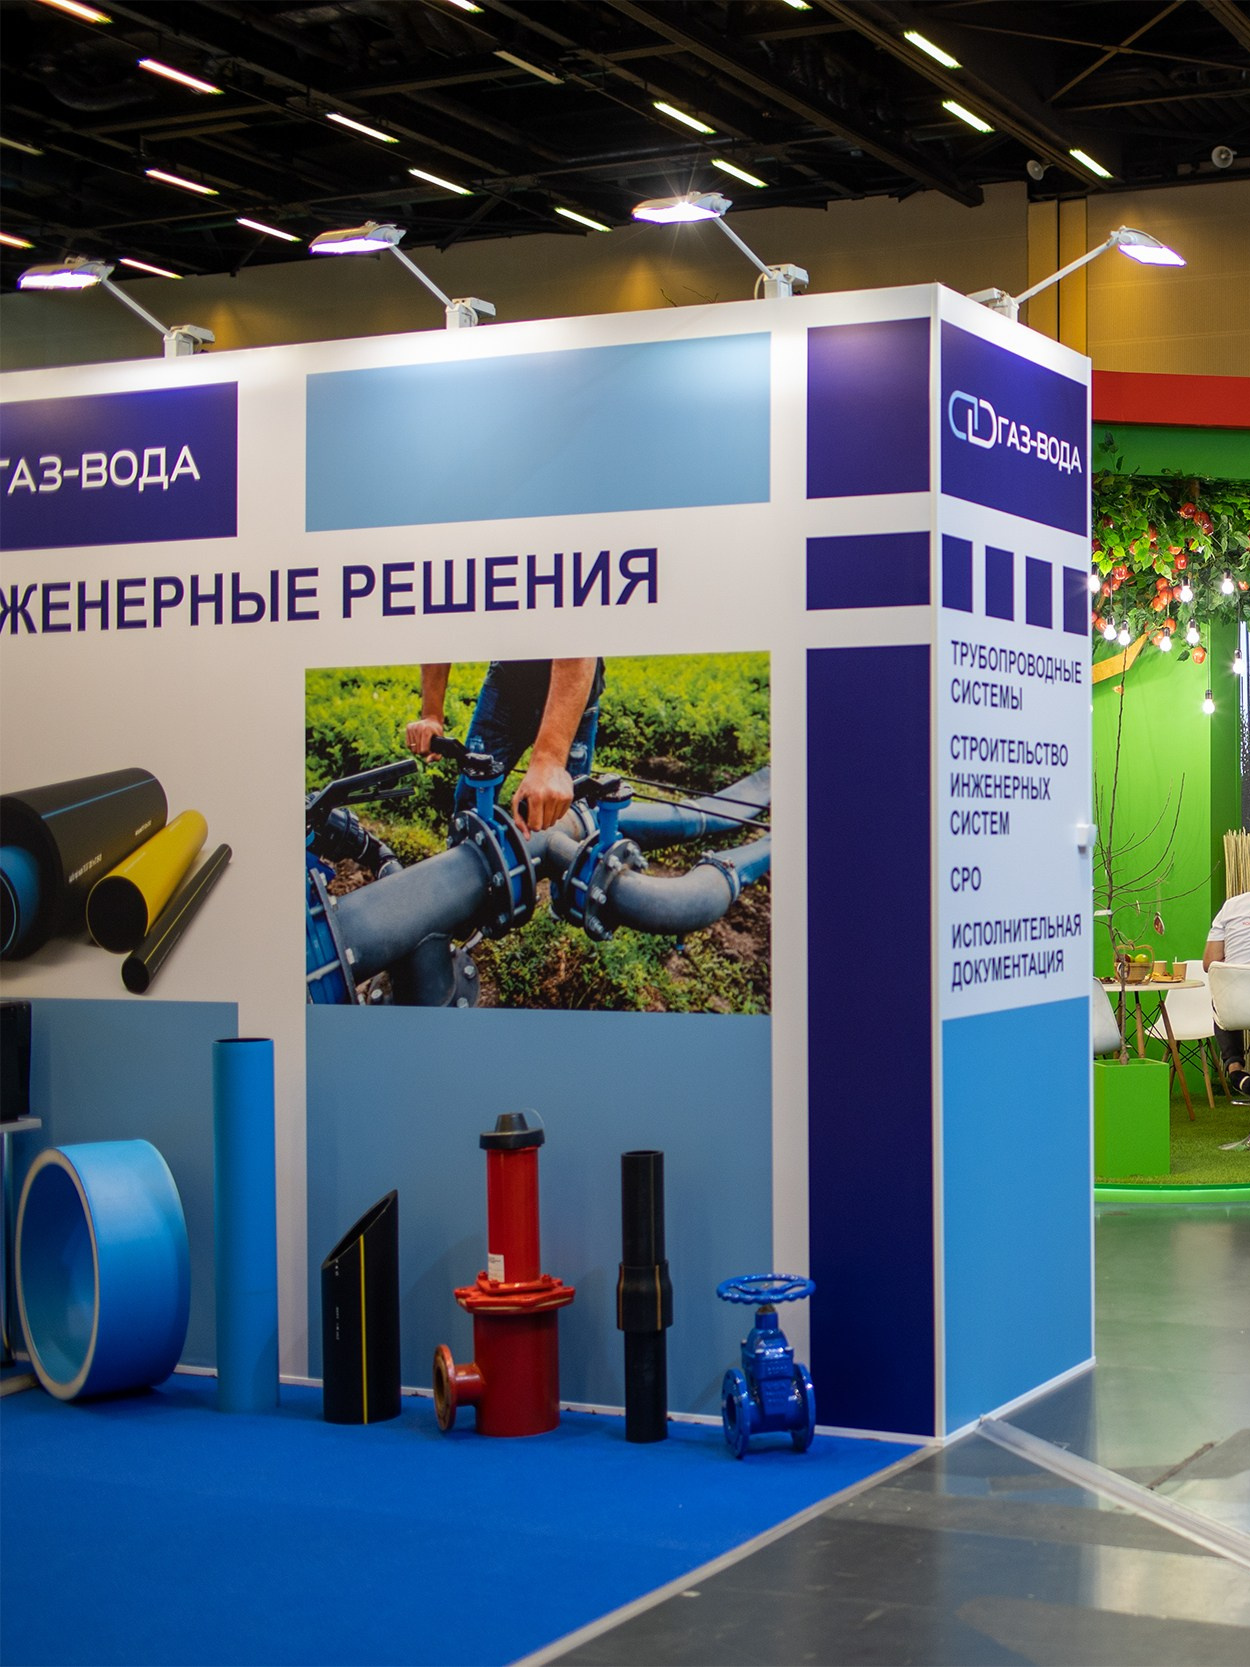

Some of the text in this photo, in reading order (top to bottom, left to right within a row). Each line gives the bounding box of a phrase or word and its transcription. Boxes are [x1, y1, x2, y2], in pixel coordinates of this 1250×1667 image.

[998, 416, 1082, 474] ГАЗ-ВОДА
[342, 547, 658, 618] РЕШЕНИЯ
[951, 640, 1082, 684] ТРУБОПРОВОДНЫЕ
[951, 678, 1023, 710] СИСТЕМЫ
[950, 734, 1069, 767] СТРОИТЕЛЬСТВО
[950, 773, 1051, 800] ИНЖЕНЕРНЫХ
[950, 810, 1010, 836] СИСТЕМ
[950, 866, 982, 892] СРО
[951, 913, 1082, 949] ИСПОЛНИТЕЛЬНАЯ
[951, 949, 1065, 993] ДОКУМЕНТАЦИЯ
